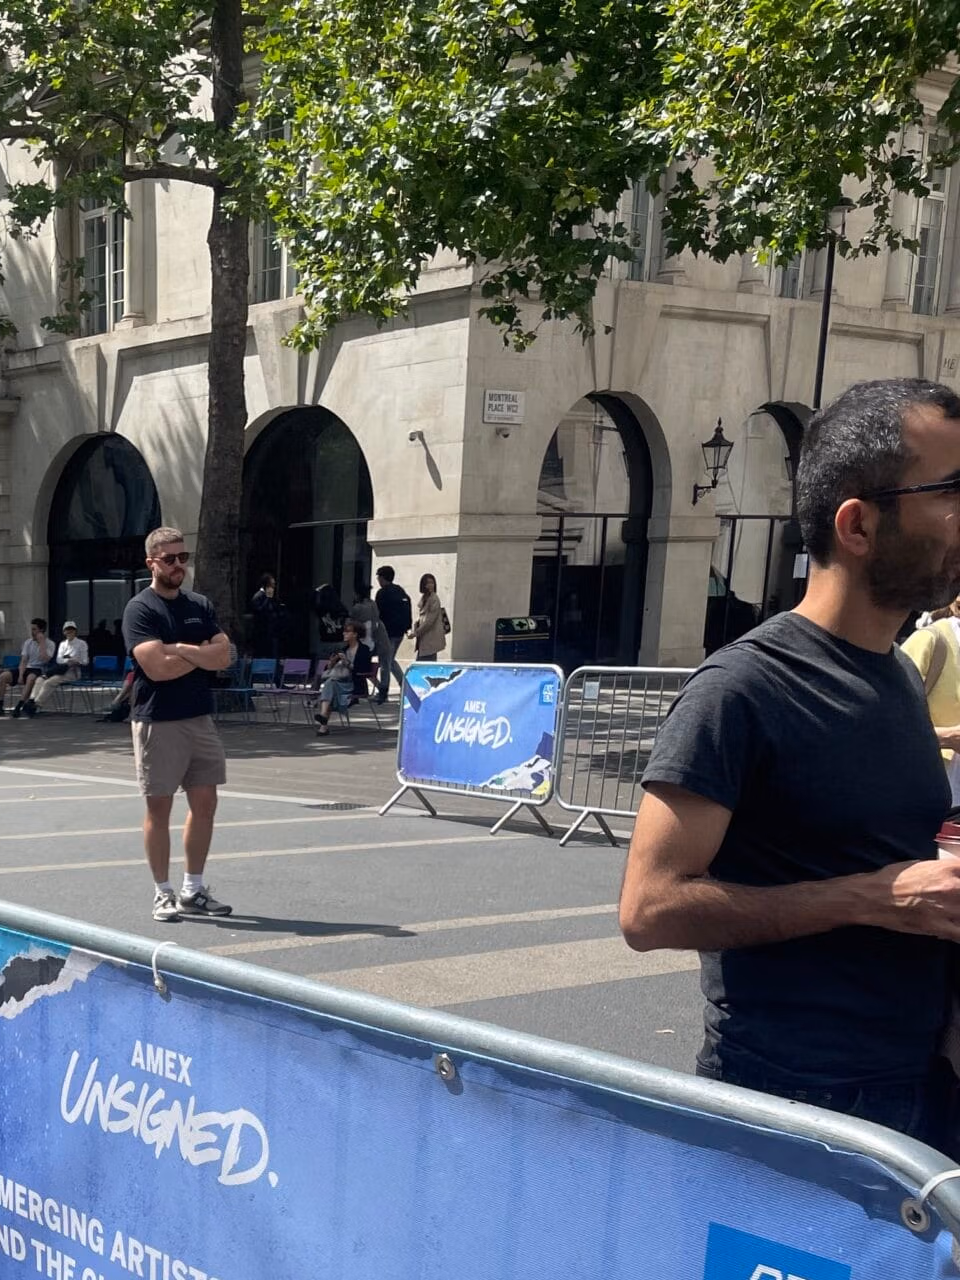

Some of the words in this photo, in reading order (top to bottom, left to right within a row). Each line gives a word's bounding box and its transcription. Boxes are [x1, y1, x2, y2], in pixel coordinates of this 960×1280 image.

[487, 403, 505, 412] PLACE
[488, 393, 519, 403] MONTREAL
[463, 700, 487, 714] AMEX
[434, 711, 514, 749] UNSIGNED.
[131, 1039, 192, 1088] AMEX
[60, 1050, 279, 1188] UNSIGNED.
